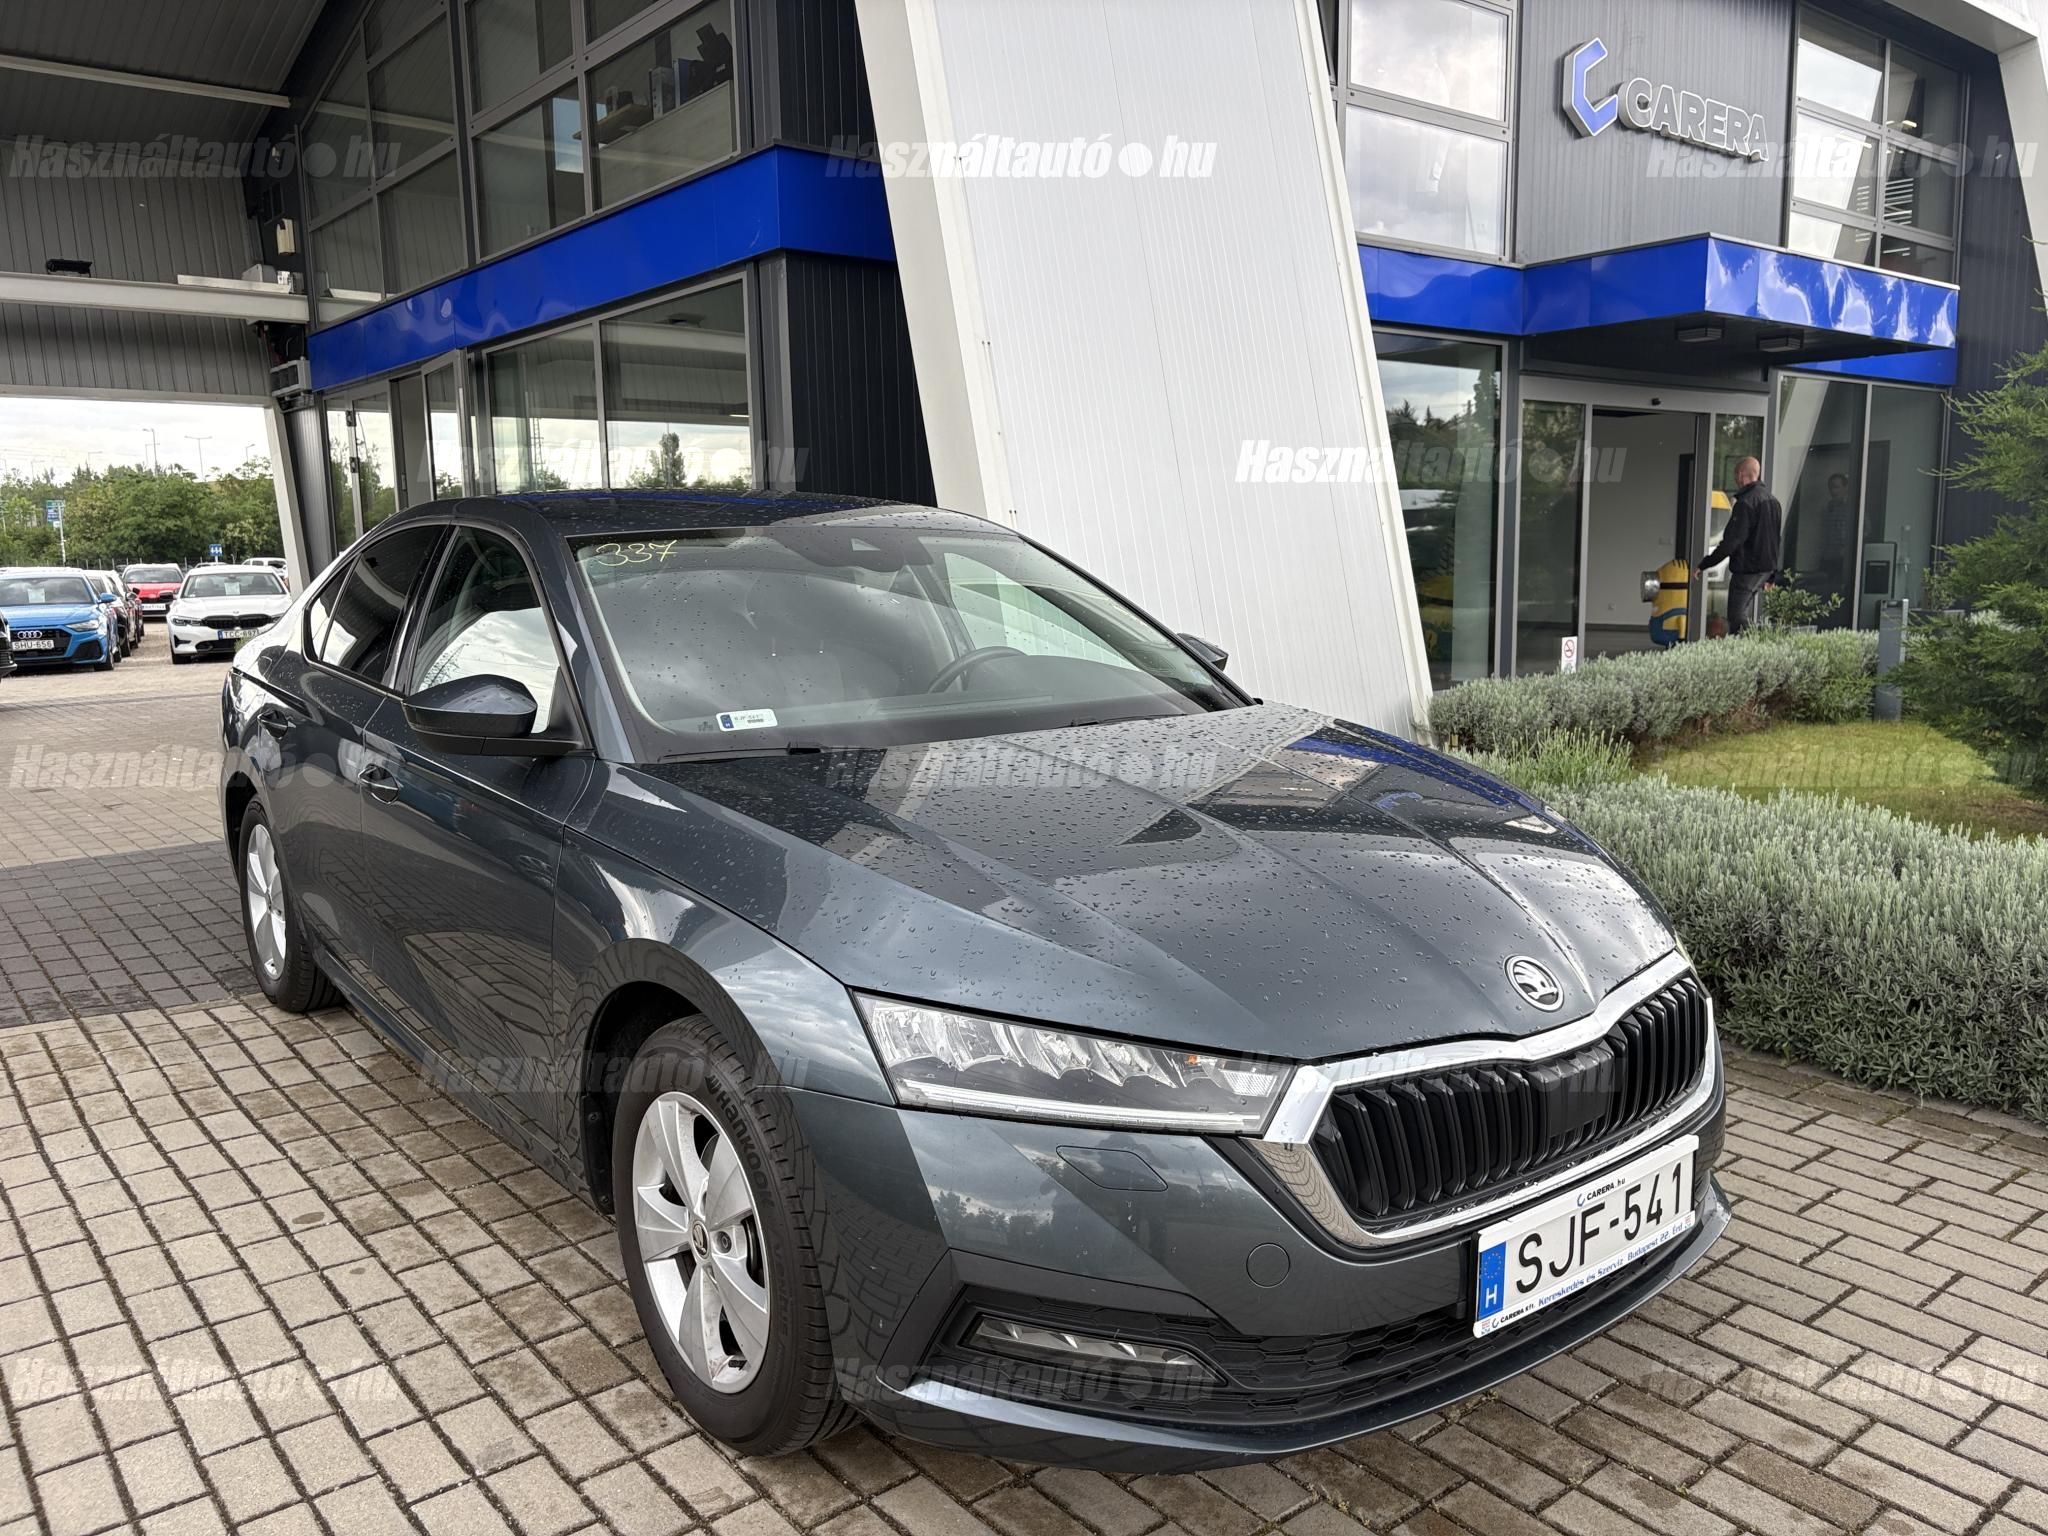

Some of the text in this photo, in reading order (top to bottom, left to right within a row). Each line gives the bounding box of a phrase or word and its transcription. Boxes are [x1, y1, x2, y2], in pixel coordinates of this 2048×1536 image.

[1620, 77, 1769, 161] CARERA
[596, 539, 678, 567] 337
[1516, 1161, 1682, 1294] SJF-541
[1485, 1283, 1498, 1309] H
[1538, 1278, 1585, 1307] Kereskedés
